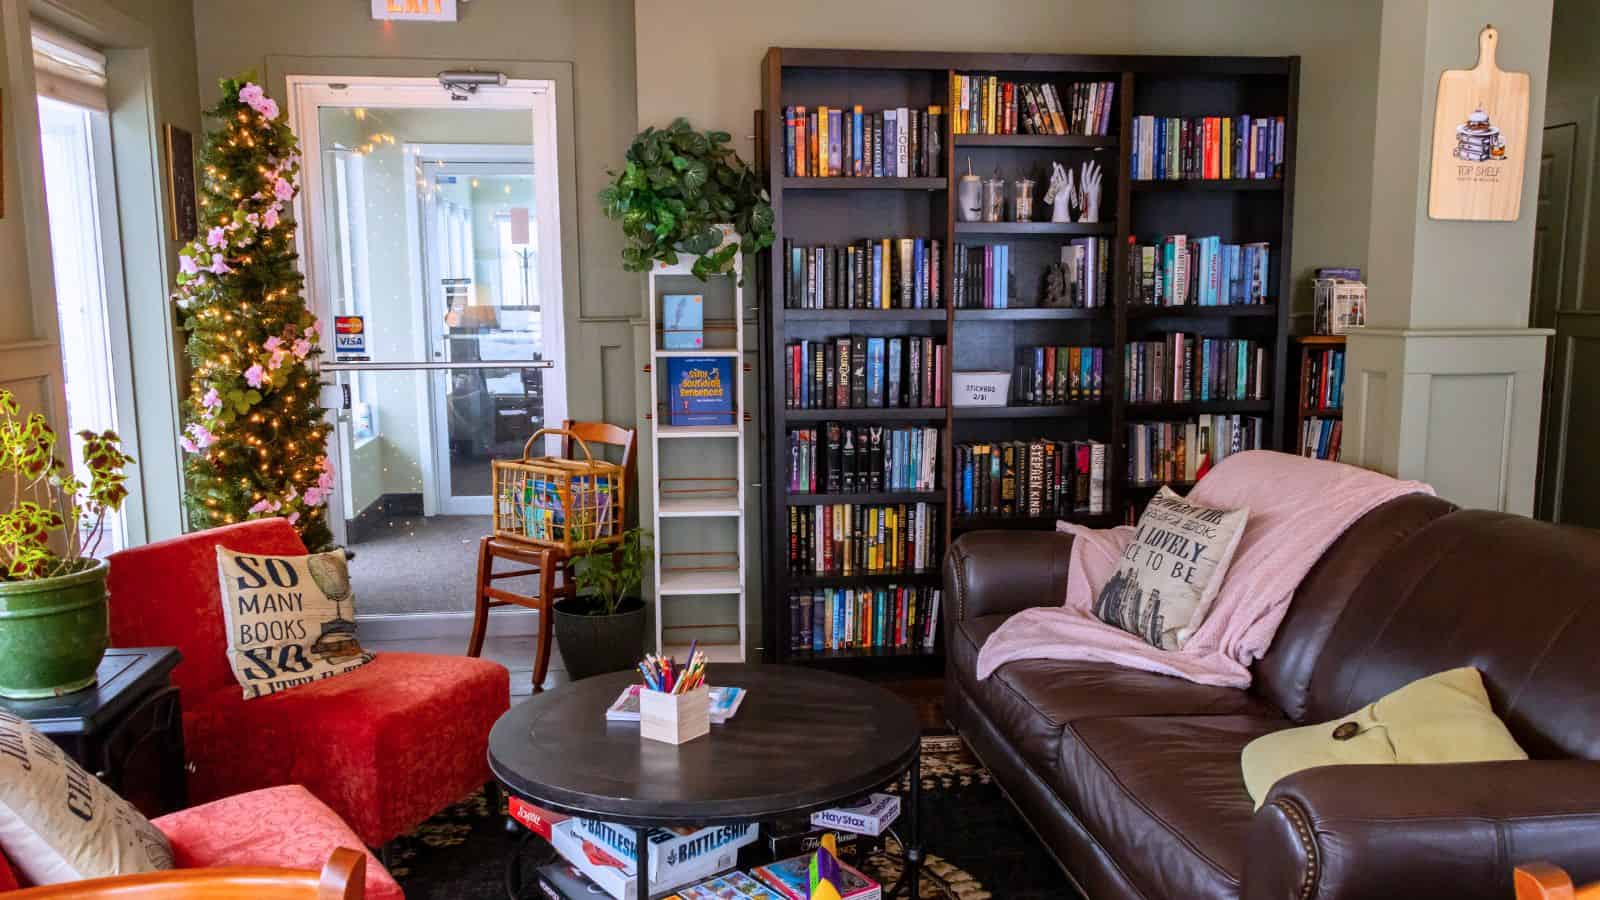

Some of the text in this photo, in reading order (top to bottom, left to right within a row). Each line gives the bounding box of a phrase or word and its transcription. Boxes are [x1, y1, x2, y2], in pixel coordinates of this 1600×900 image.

[1456, 165, 1501, 177] TOP SHELF
[339, 336, 362, 345] VISA
[966, 384, 996, 393] STICKERS
[1029, 443, 1043, 514] STEPHEN KING
[1145, 526, 1208, 563] LOVELY
[235, 556, 299, 590] SO
[1146, 550, 1164, 571] TO
[1171, 561, 1197, 585] BE
[238, 592, 303, 616] MANY
[240, 619, 307, 645] BOOKS
[588, 818, 638, 862] BATTLESH
[679, 823, 751, 864] BATTLESHIP
